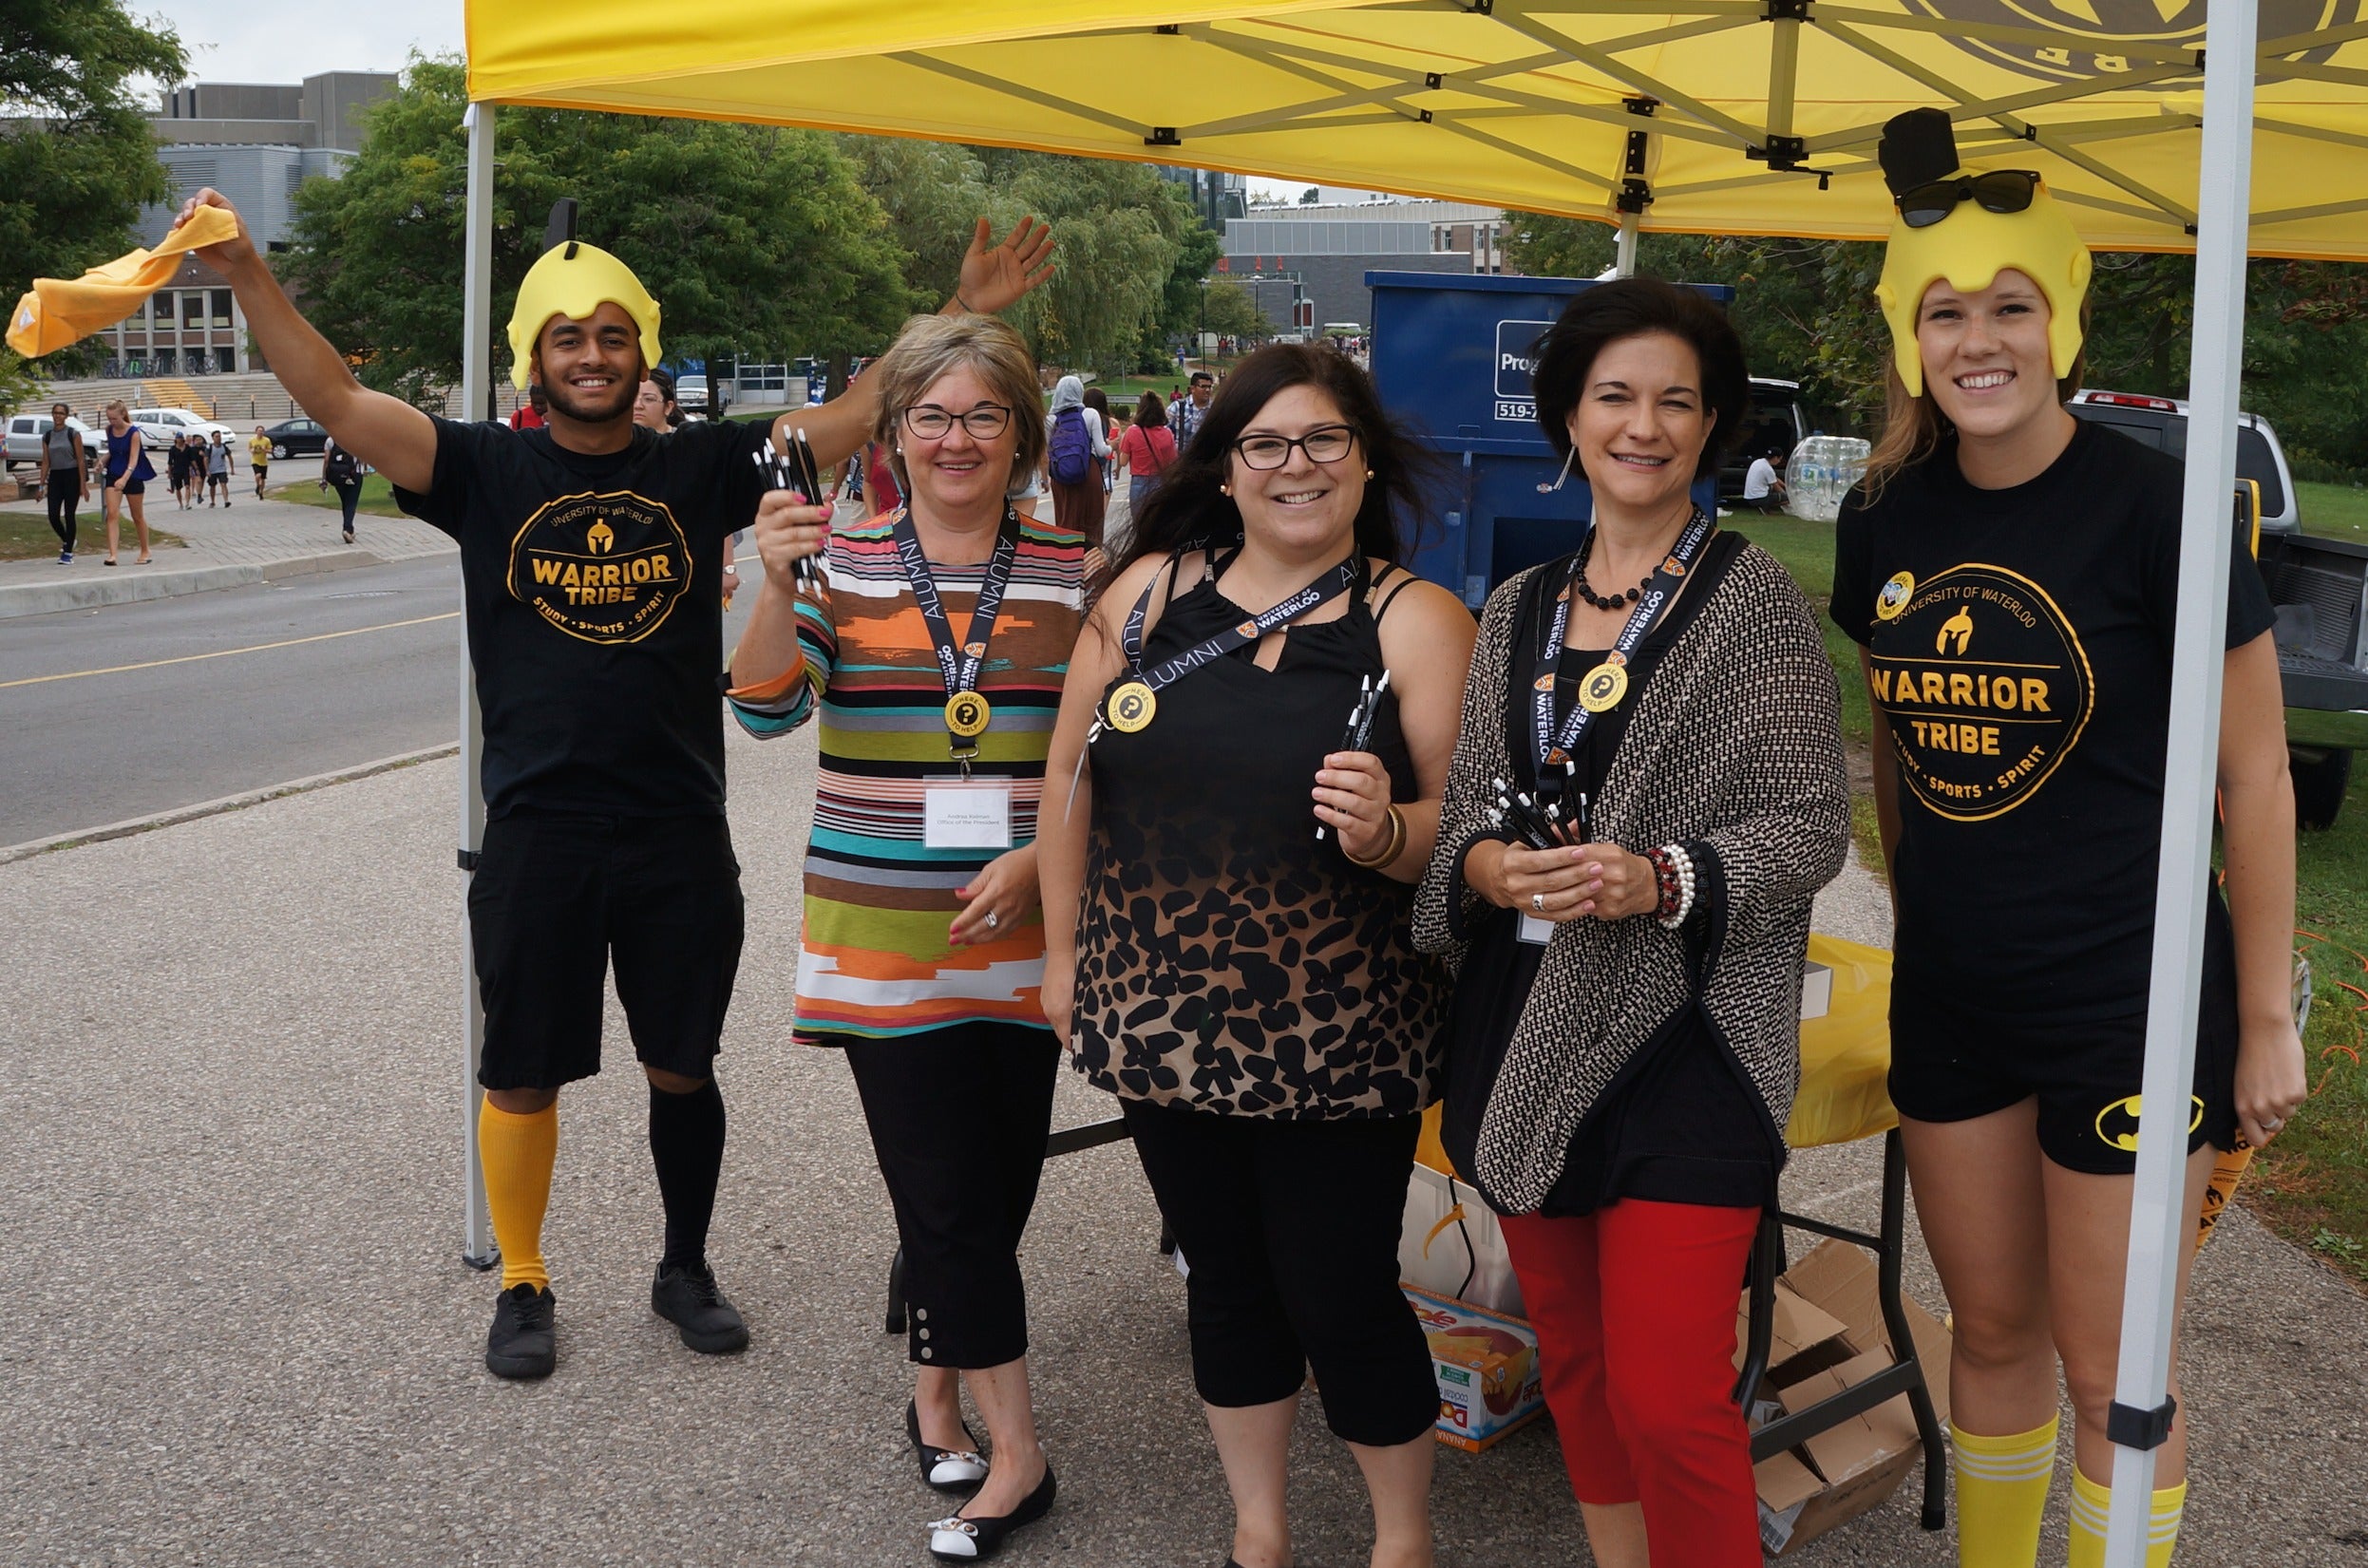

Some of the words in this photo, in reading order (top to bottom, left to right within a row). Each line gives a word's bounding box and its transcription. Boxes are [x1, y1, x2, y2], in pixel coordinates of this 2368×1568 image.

[598, 506, 610, 515] OF
[532, 554, 673, 587] WARRIOR
[899, 538, 945, 619] ALUMNI
[976, 535, 1014, 620] ALUMNI
[533, 595, 569, 624] STUDY
[578, 621, 625, 634] SPORTS
[635, 590, 666, 623] SPIRIT
[564, 586, 638, 606] TRIBE
[1257, 592, 1320, 629] WATERLOO
[1258, 595, 1300, 621] UNIVERSITY
[1301, 588, 1311, 596] OF
[1892, 586, 1961, 625] UNIVERSITY
[1962, 586, 1980, 599] OF
[1981, 587, 2037, 630] WATERLOO
[1544, 601, 1564, 660] WATERLOO
[1618, 602, 1645, 646] UNIVERSITY
[1643, 591, 1652, 600] OF
[1620, 591, 1664, 651] WATERLOO
[1606, 668, 1621, 682] HERE
[1869, 667, 2052, 712] WARRIOR
[958, 696, 979, 705] HERE
[1131, 688, 1148, 702] HERE
[1586, 698, 1602, 707] HELP
[952, 721, 960, 730] TO
[961, 724, 978, 733] HELP
[1117, 719, 1135, 727] HELP
[1911, 721, 2001, 756] TRIBE
[1892, 728, 1921, 773] STUDY
[1929, 776, 1982, 799] SPORTS
[1998, 745, 2046, 789] SPIRIT
